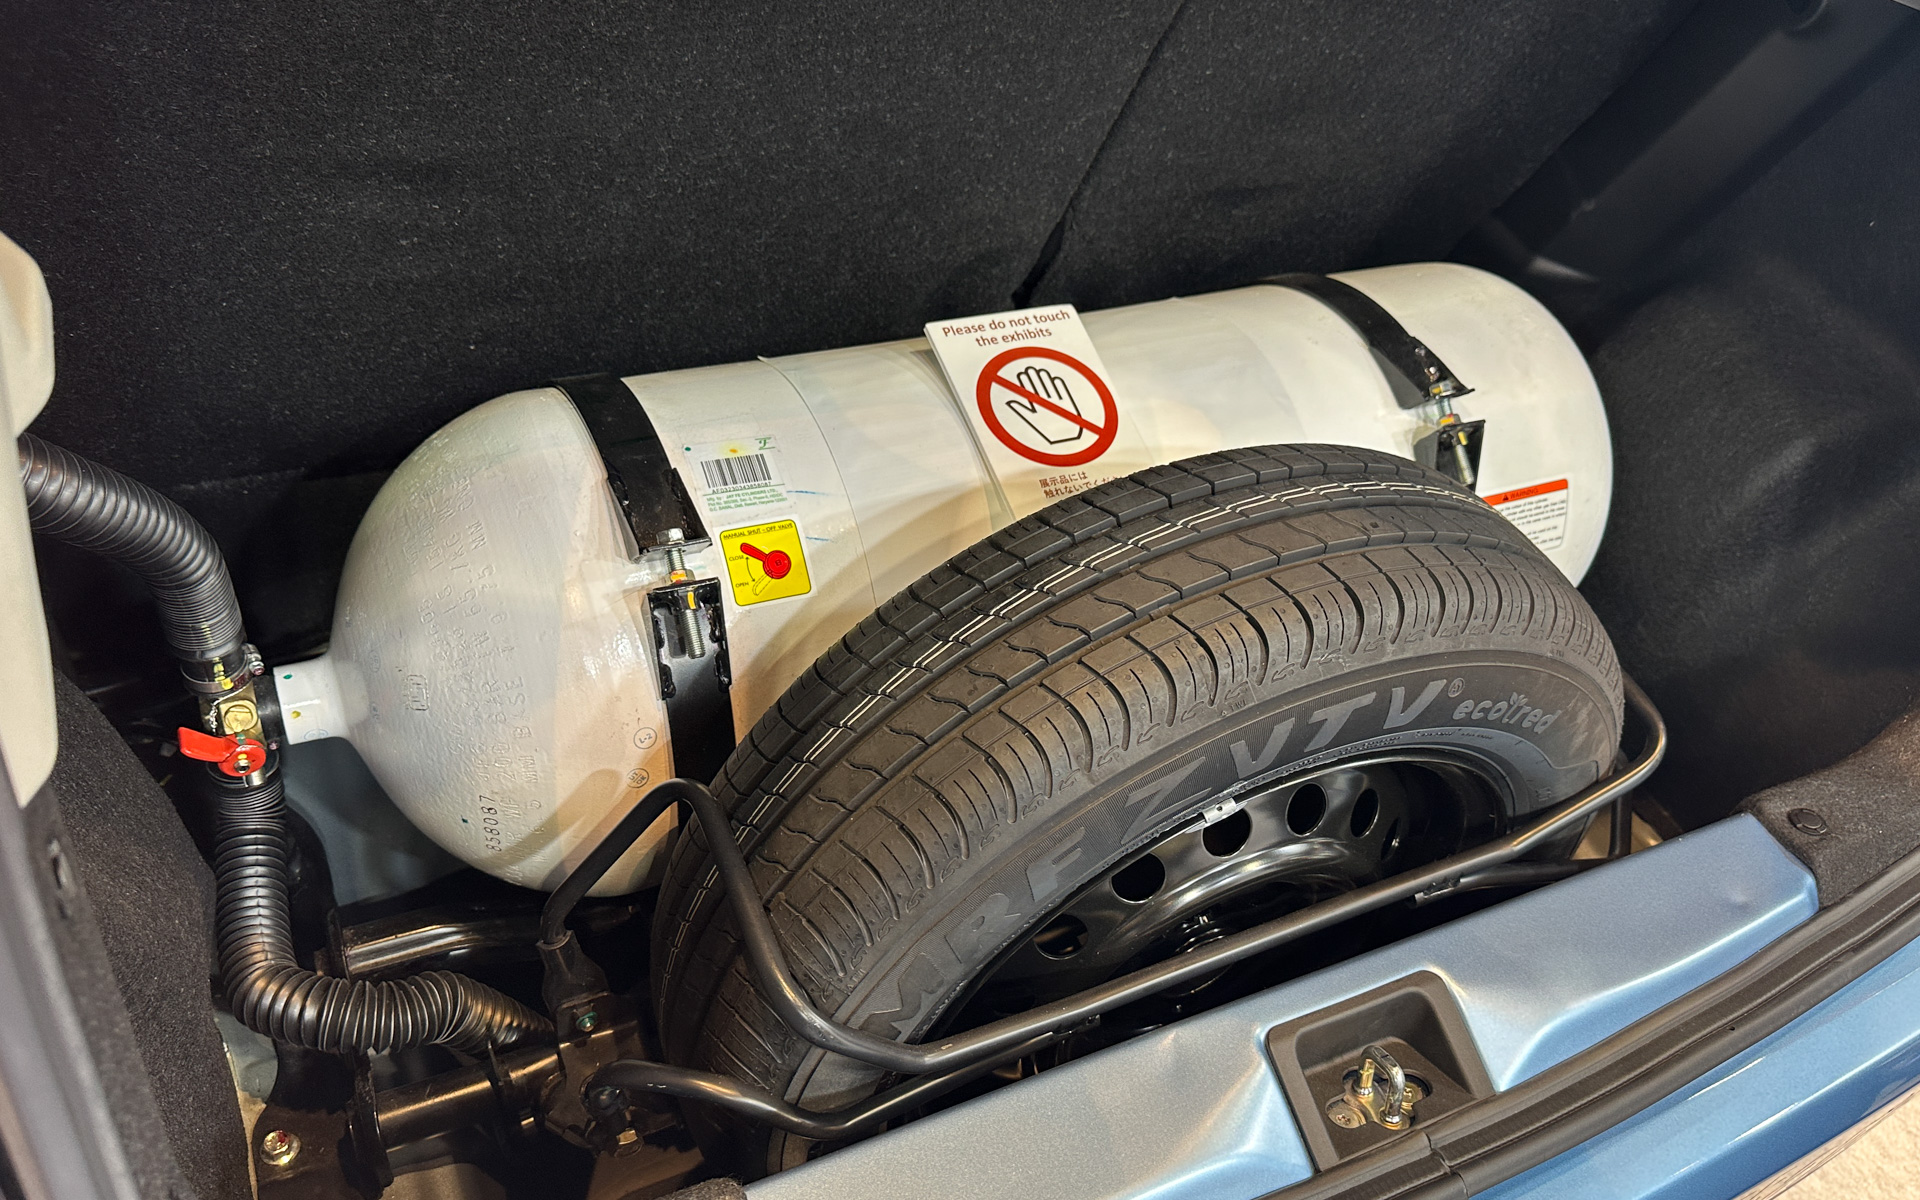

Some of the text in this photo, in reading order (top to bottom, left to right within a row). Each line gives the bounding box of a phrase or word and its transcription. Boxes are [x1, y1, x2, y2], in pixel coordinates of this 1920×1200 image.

[942, 310, 1071, 337] Please do not touch
[975, 327, 1053, 347] the exhibits
[1039, 471, 1088, 488] 展示品には
[723, 531, 746, 540] MANUAL
[479, 795, 502, 851] 858087
[858, 827, 1086, 1042] MRF
